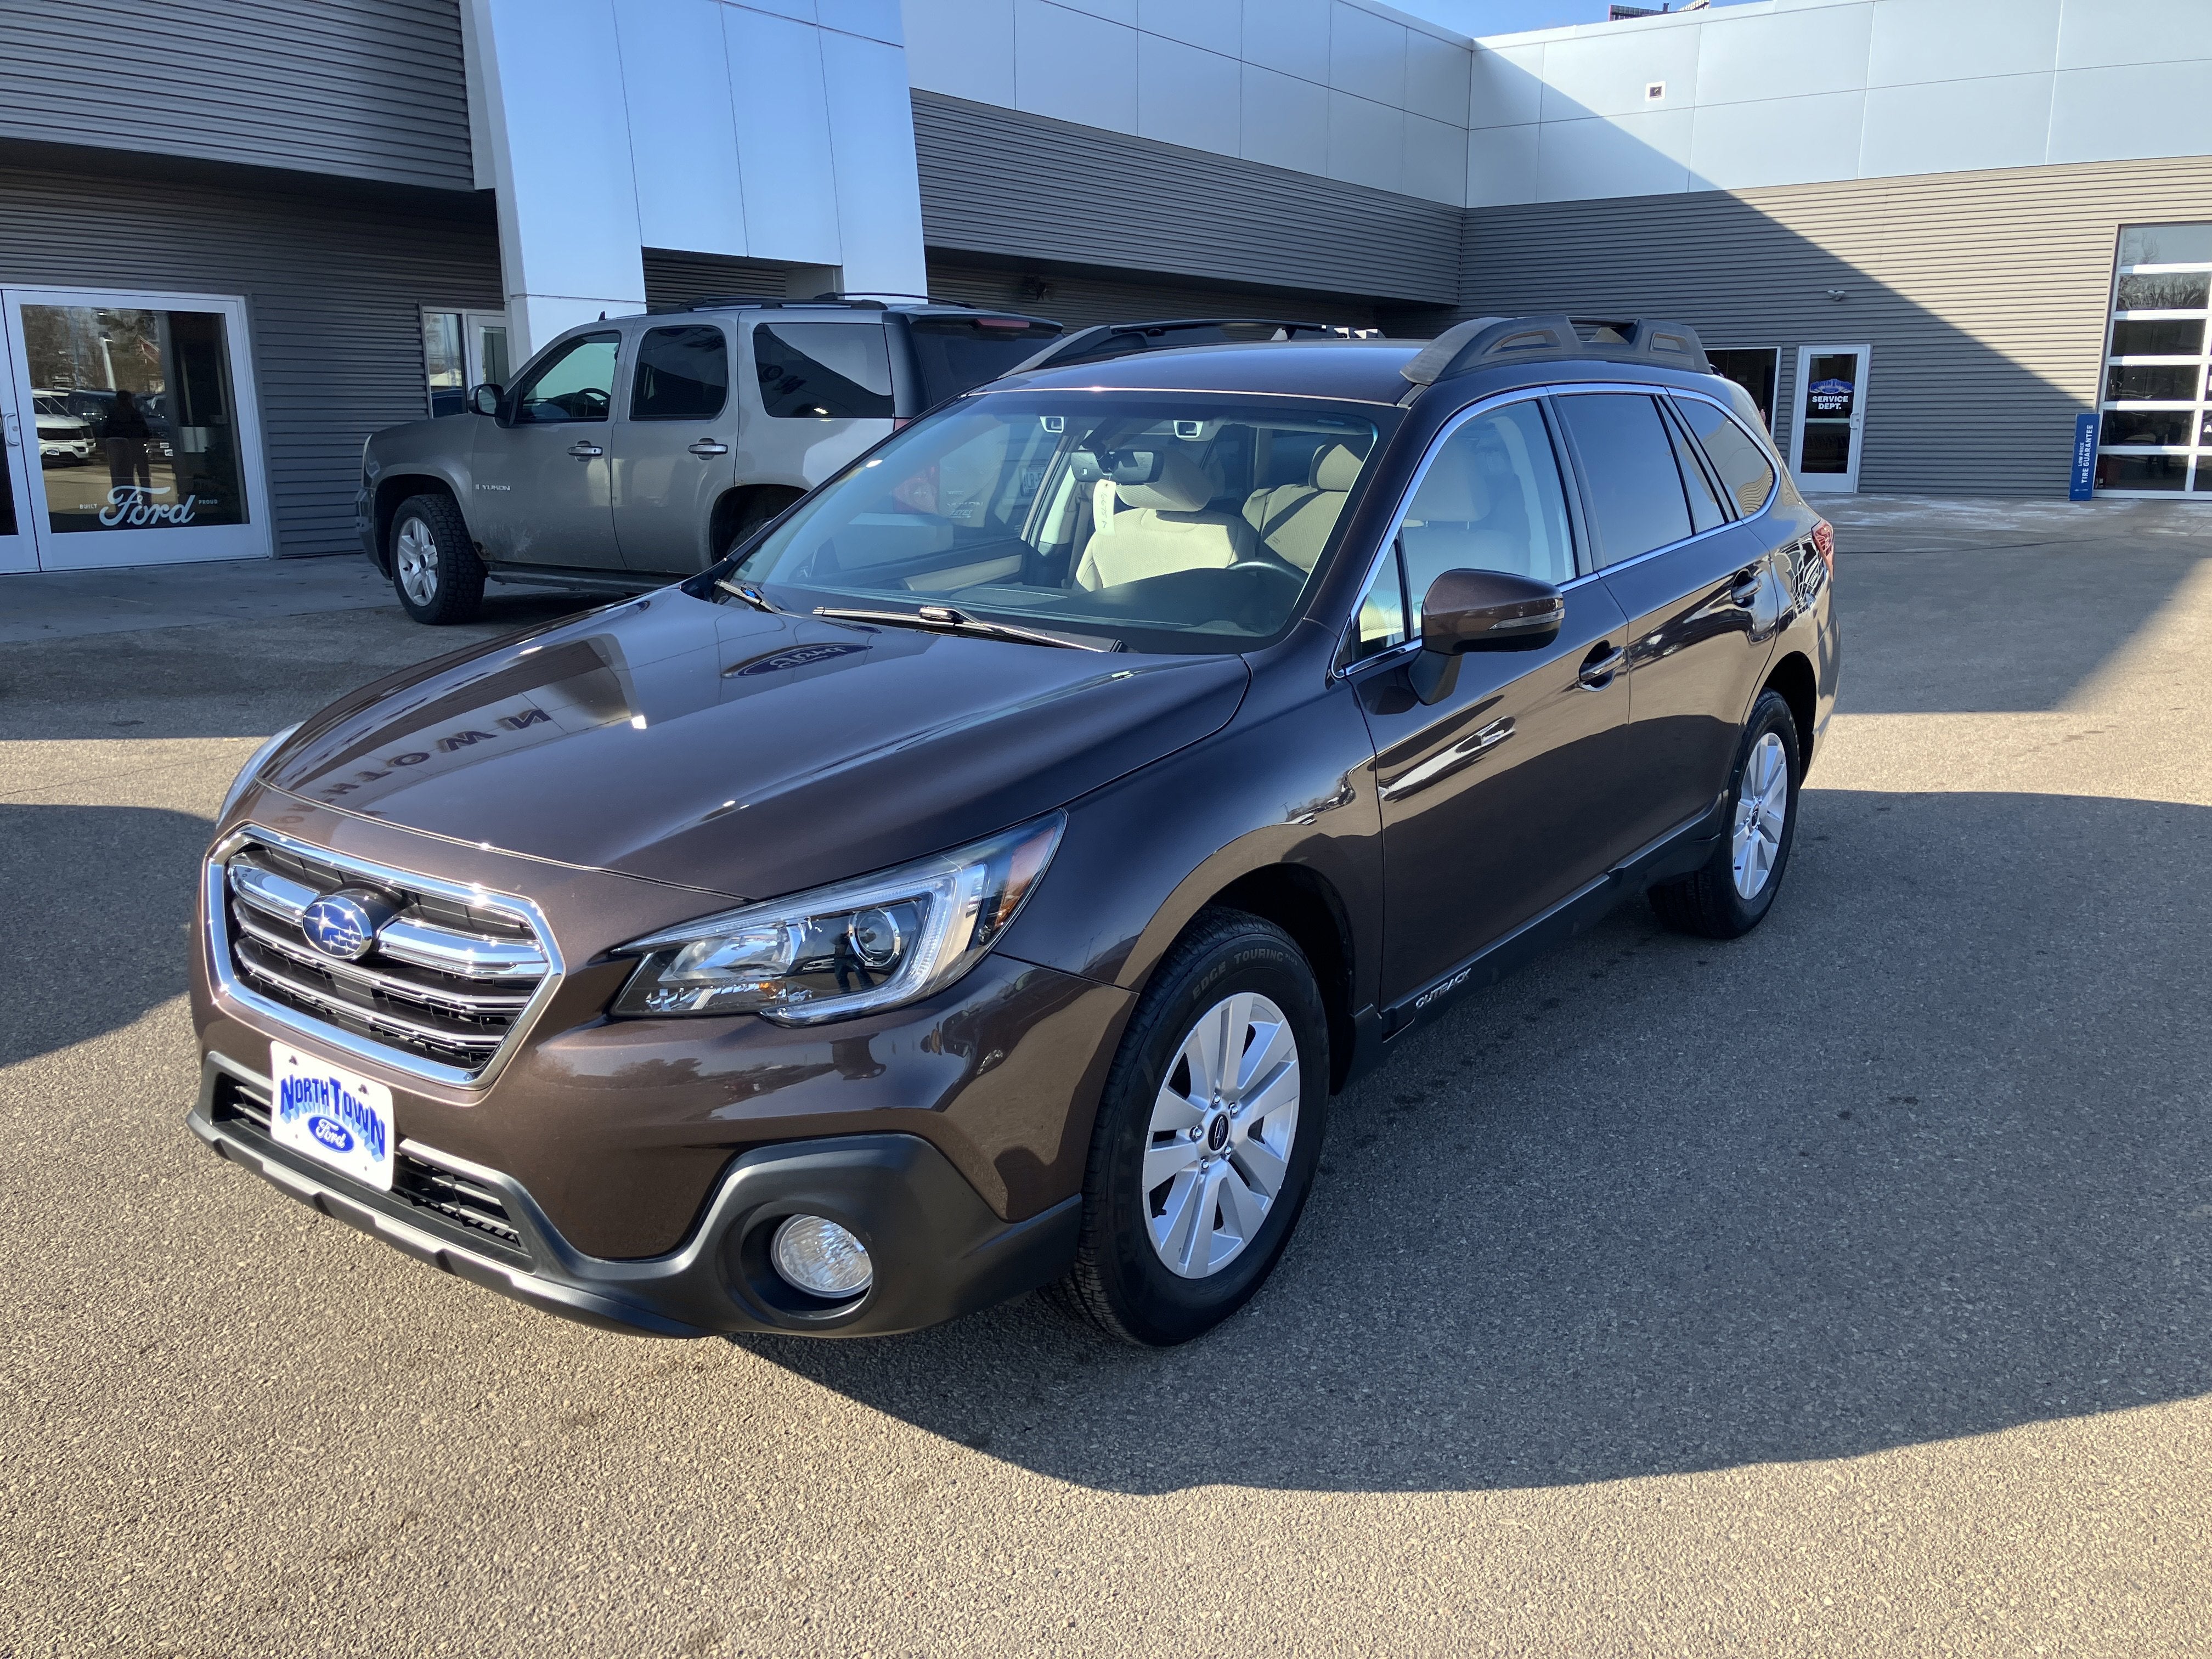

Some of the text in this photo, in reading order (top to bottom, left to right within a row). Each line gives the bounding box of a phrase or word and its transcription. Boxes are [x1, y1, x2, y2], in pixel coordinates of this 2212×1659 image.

[2084, 425, 2094, 467] GUARANTEE
[99, 485, 195, 526] Ford
[1192, 961, 1226, 1000] EDGE
[1234, 948, 1284, 964] TOURING
[280, 1074, 386, 1161] NORTH TOWN
[315, 1119, 347, 1148] Ford
